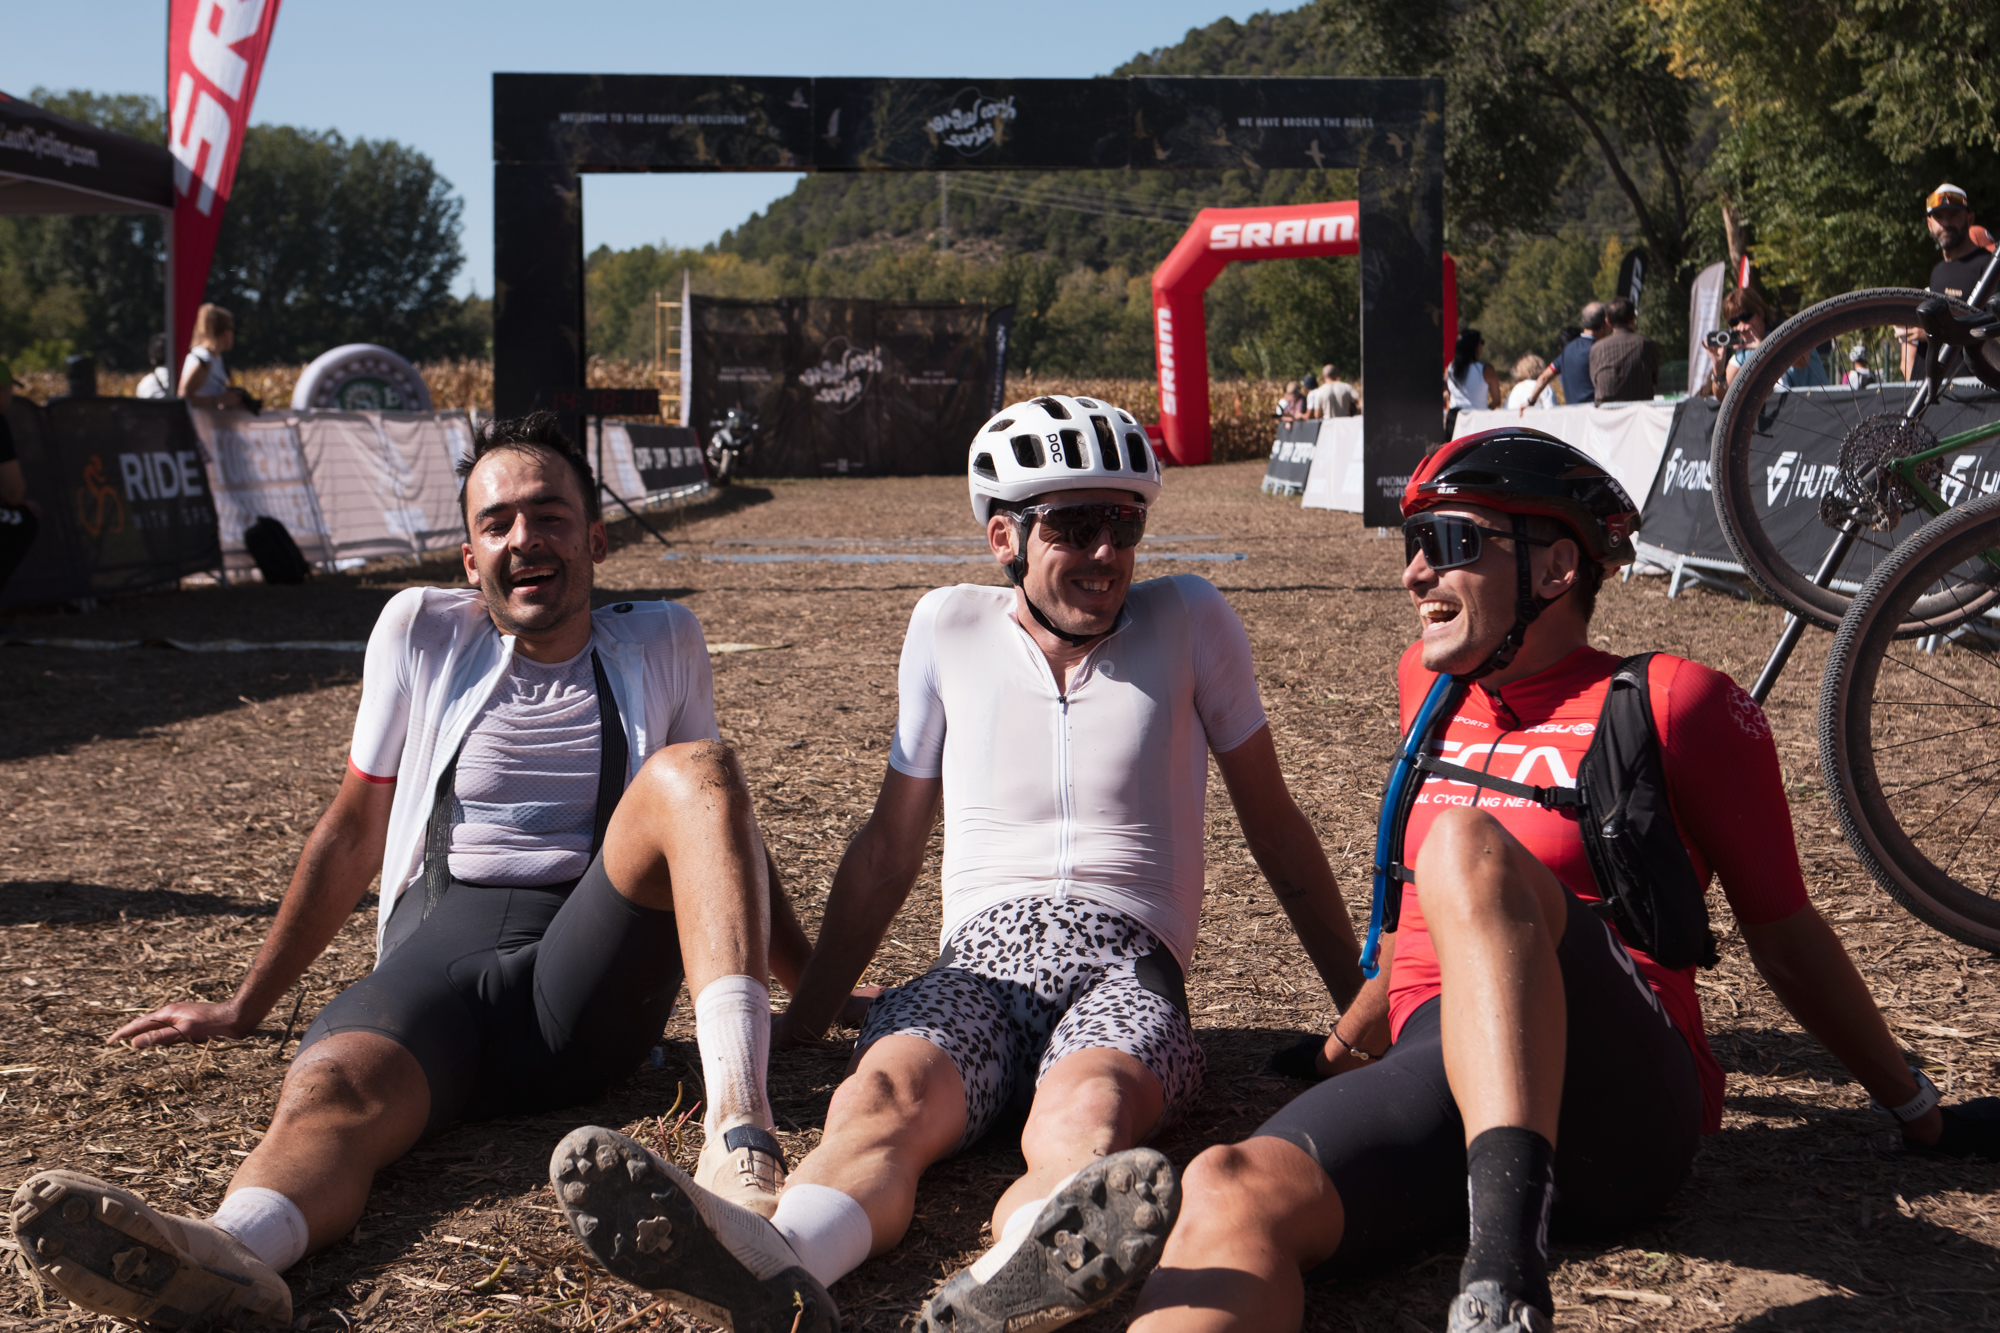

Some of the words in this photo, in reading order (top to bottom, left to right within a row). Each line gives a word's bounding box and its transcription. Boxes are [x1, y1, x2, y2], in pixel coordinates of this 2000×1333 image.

[172, 0, 266, 216] SR
[558, 112, 607, 123] WELCOME
[610, 113, 623, 123] TO
[626, 113, 644, 123] THE
[646, 113, 684, 124] GRAVEL
[686, 114, 747, 125] REVOLUTION
[1238, 117, 1253, 127] WE
[1255, 117, 1280, 127] HAVE
[1282, 117, 1320, 127] BROKEN
[1323, 117, 1341, 127] THE
[1343, 117, 1374, 128] RULES
[1209, 215, 1355, 249] SRAM
[1157, 307, 1177, 416] SRAM
[1046, 433, 1063, 463] POC
[119, 451, 204, 502] RIDE
[1376, 475, 1411, 487] #NONA
[1437, 486, 1459, 494] HJC
[1607, 480, 1634, 511] HJC
[181, 506, 212, 526] GPS
[1451, 715, 1490, 729] SPORTS
[1523, 724, 1573, 734] AGU
[1433, 793, 1500, 808] CYCLING
